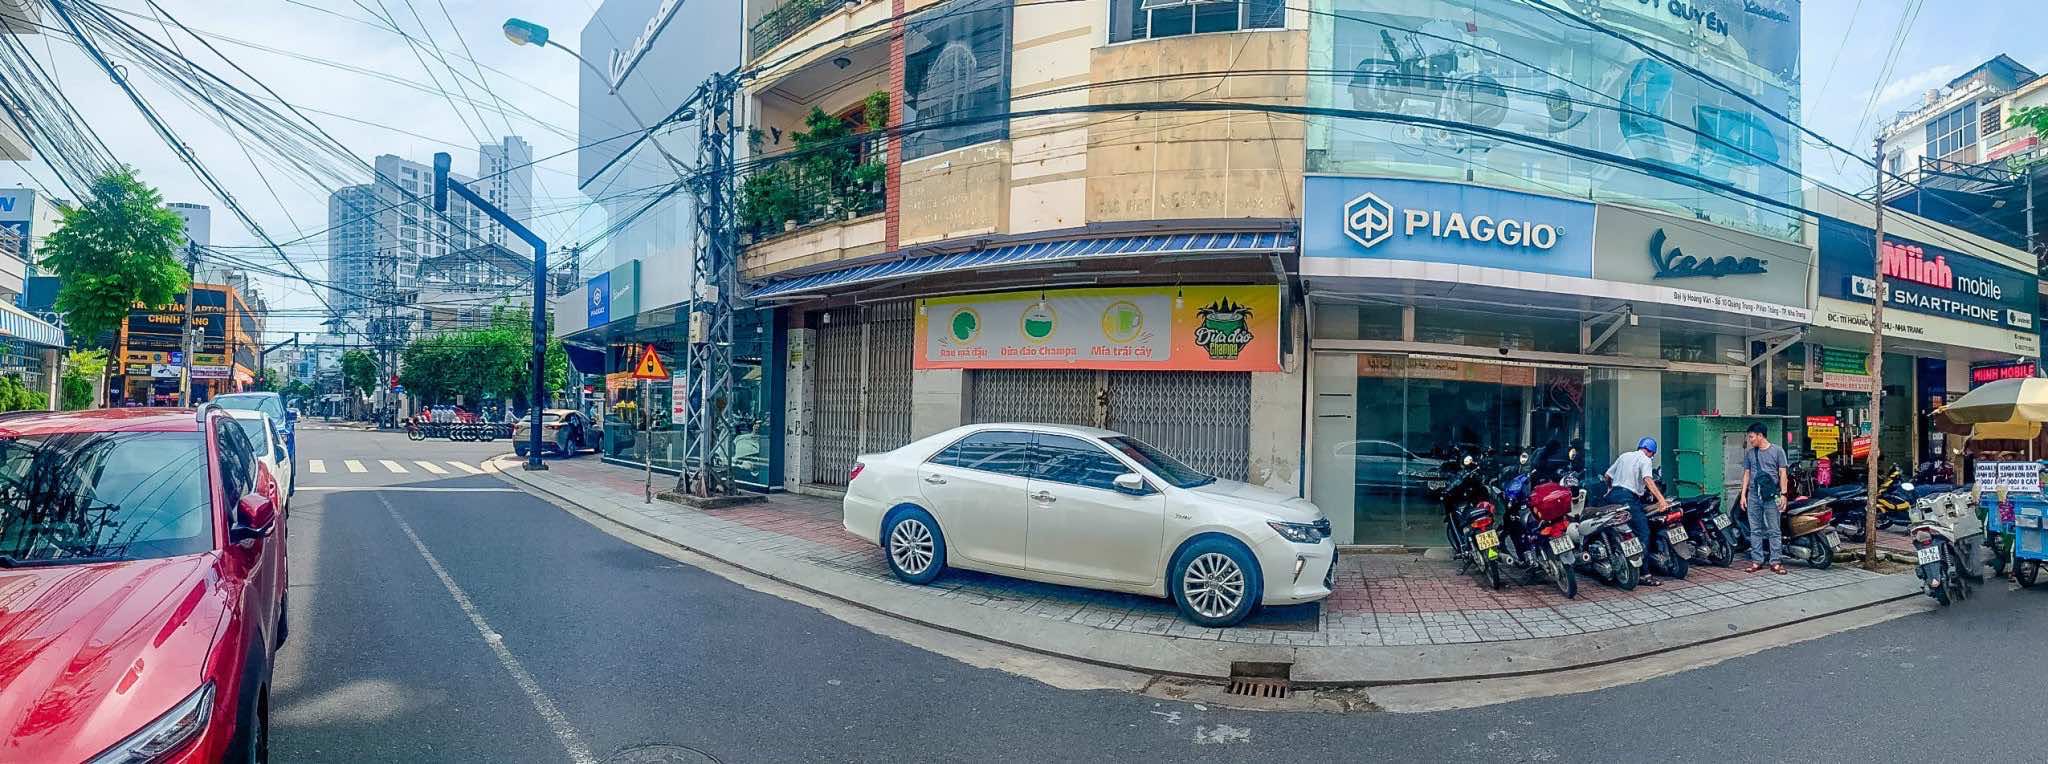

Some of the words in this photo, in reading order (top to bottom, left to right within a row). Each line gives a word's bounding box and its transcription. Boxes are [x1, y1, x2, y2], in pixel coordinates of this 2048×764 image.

[1404, 208, 1557, 249] PIAGGIO
[1650, 228, 1769, 280] Vespa
[1882, 241, 1953, 289] Miinh
[1958, 276, 2001, 300] mobile
[1895, 290, 1999, 322] SMARTPHONE
[1906, 324, 1923, 335] TRANG
[1038, 346, 1077, 357] Champa
[1111, 347, 1131, 357] trái
[1209, 342, 1239, 356] Champa
[2000, 364, 2035, 379] MOBILE
